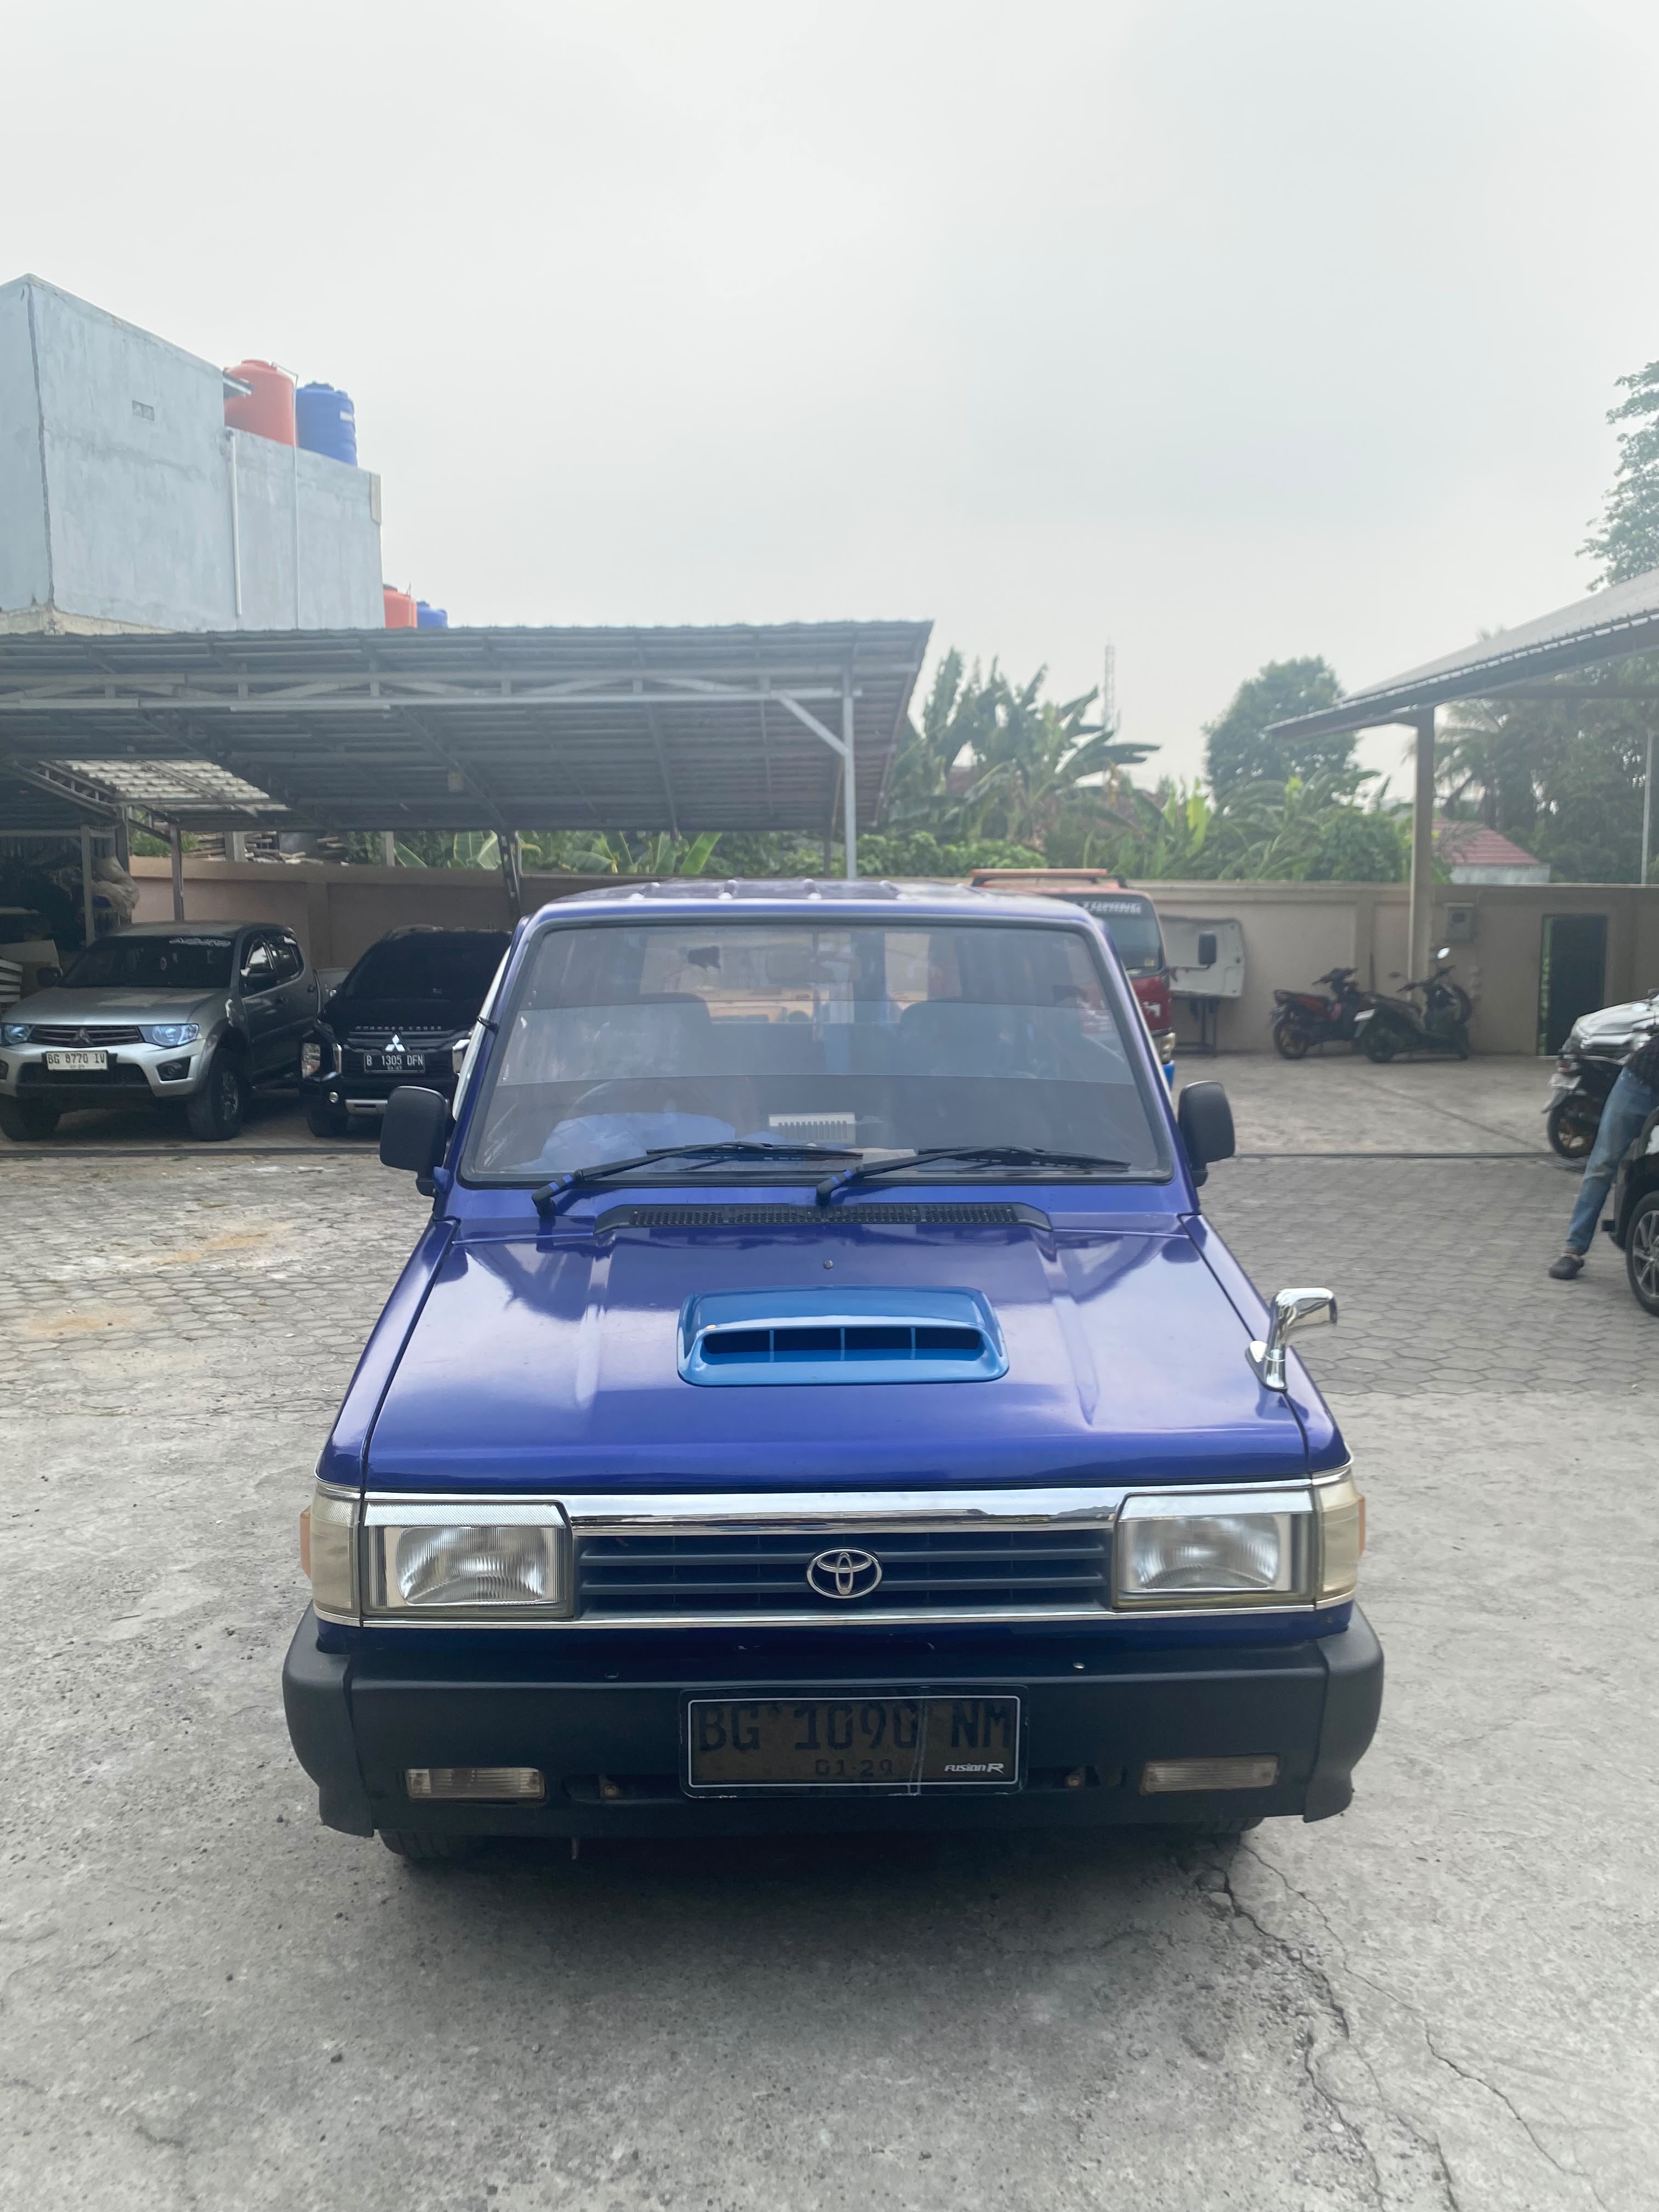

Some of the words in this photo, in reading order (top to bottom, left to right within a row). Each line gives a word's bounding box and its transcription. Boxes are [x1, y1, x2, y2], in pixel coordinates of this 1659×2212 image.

[48, 1053, 60, 1064] BG
[65, 1053, 88, 1063] 8770
[366, 1055, 373, 1066] B
[381, 1055, 402, 1066] 1305
[407, 1055, 424, 1066] DFN
[698, 1702, 761, 1751] BG
[793, 1701, 918, 1750] 1090
[951, 1699, 1012, 1749] NM
[987, 1763, 1005, 1774] R
